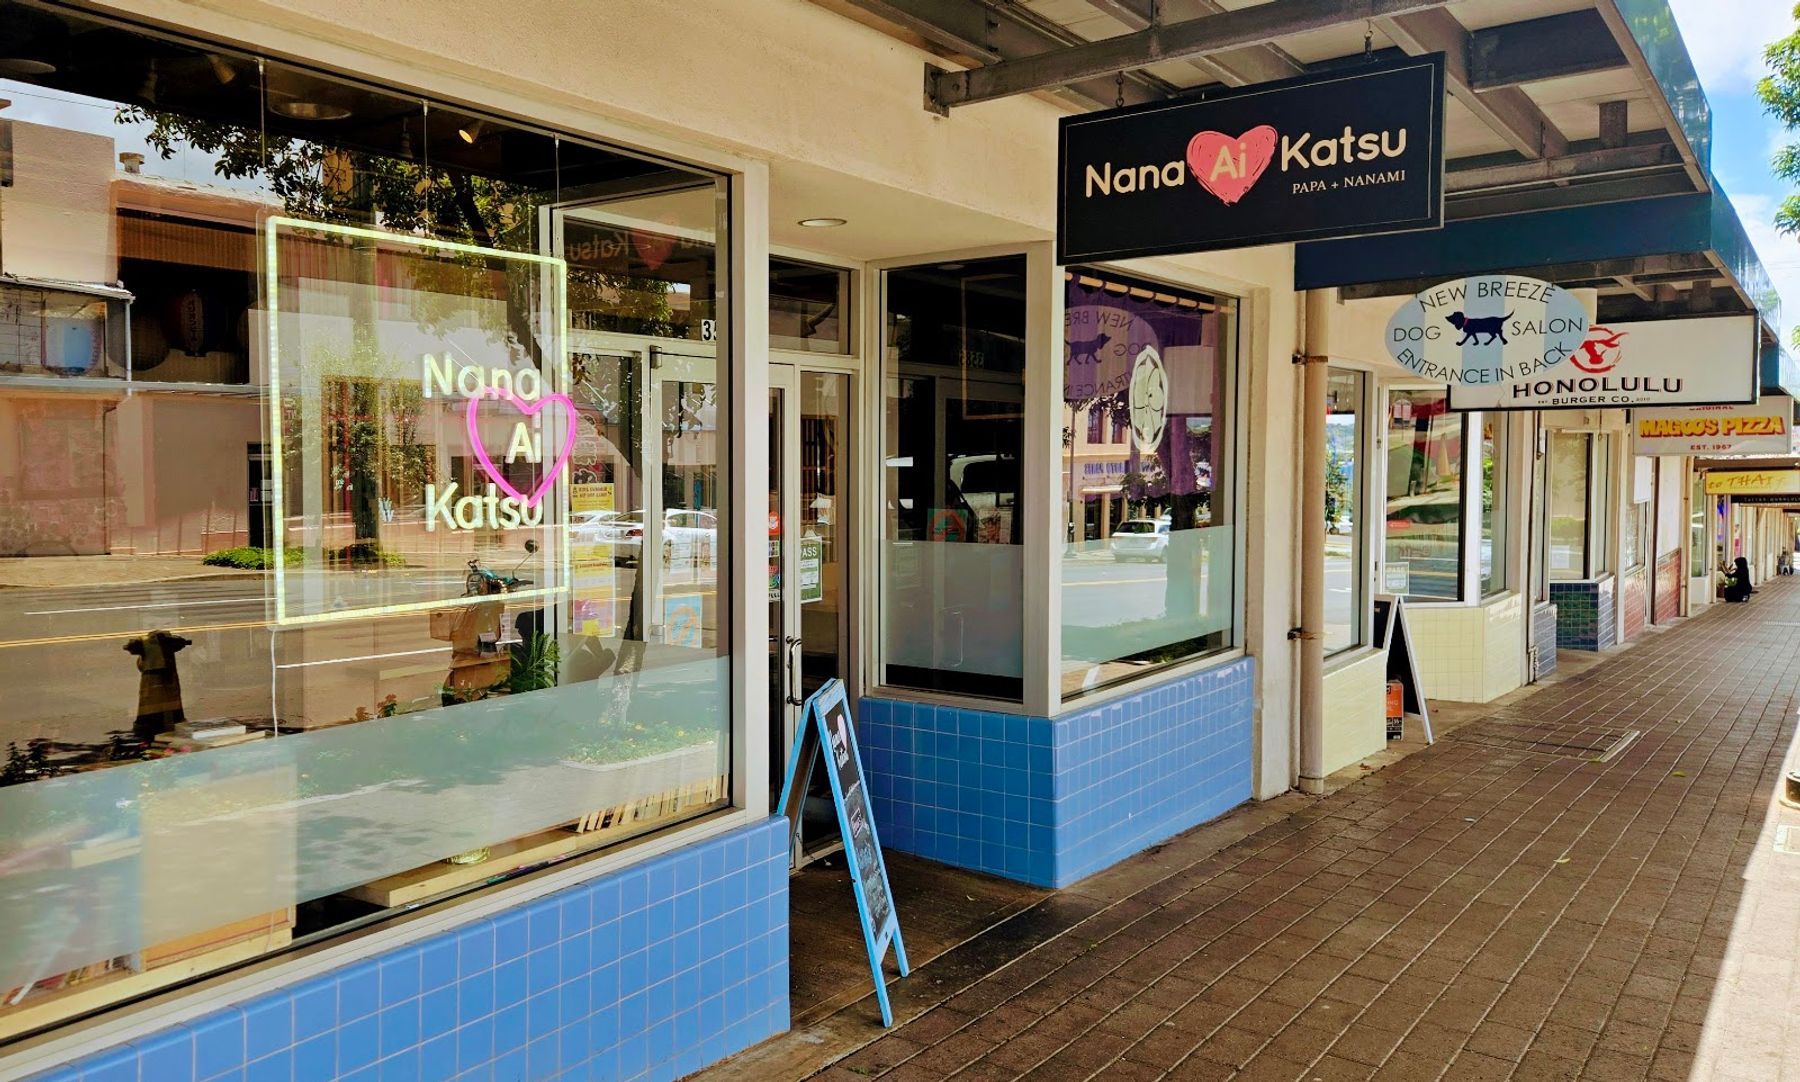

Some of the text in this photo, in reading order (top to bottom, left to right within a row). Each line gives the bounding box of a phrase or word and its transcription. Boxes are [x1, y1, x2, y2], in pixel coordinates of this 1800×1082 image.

[1085, 126, 1407, 198] Nana Ai Katsu
[1292, 180, 1327, 194] PAPA
[1343, 170, 1406, 188] NANAMI
[1419, 281, 1556, 312] NEW BREEZE
[1393, 317, 1583, 342] DOG SALON
[423, 352, 541, 401] Nana
[1397, 341, 1573, 384] ENTRANCE IN BACK
[1512, 376, 1684, 398] HONOLULU
[1552, 396, 1607, 405] BURGER
[1611, 395, 1635, 403] CO.
[505, 411, 542, 464] Ai
[1722, 416, 1786, 436] PIZZA
[425, 482, 544, 532] Katsu
[800, 546, 817, 558] ASS
